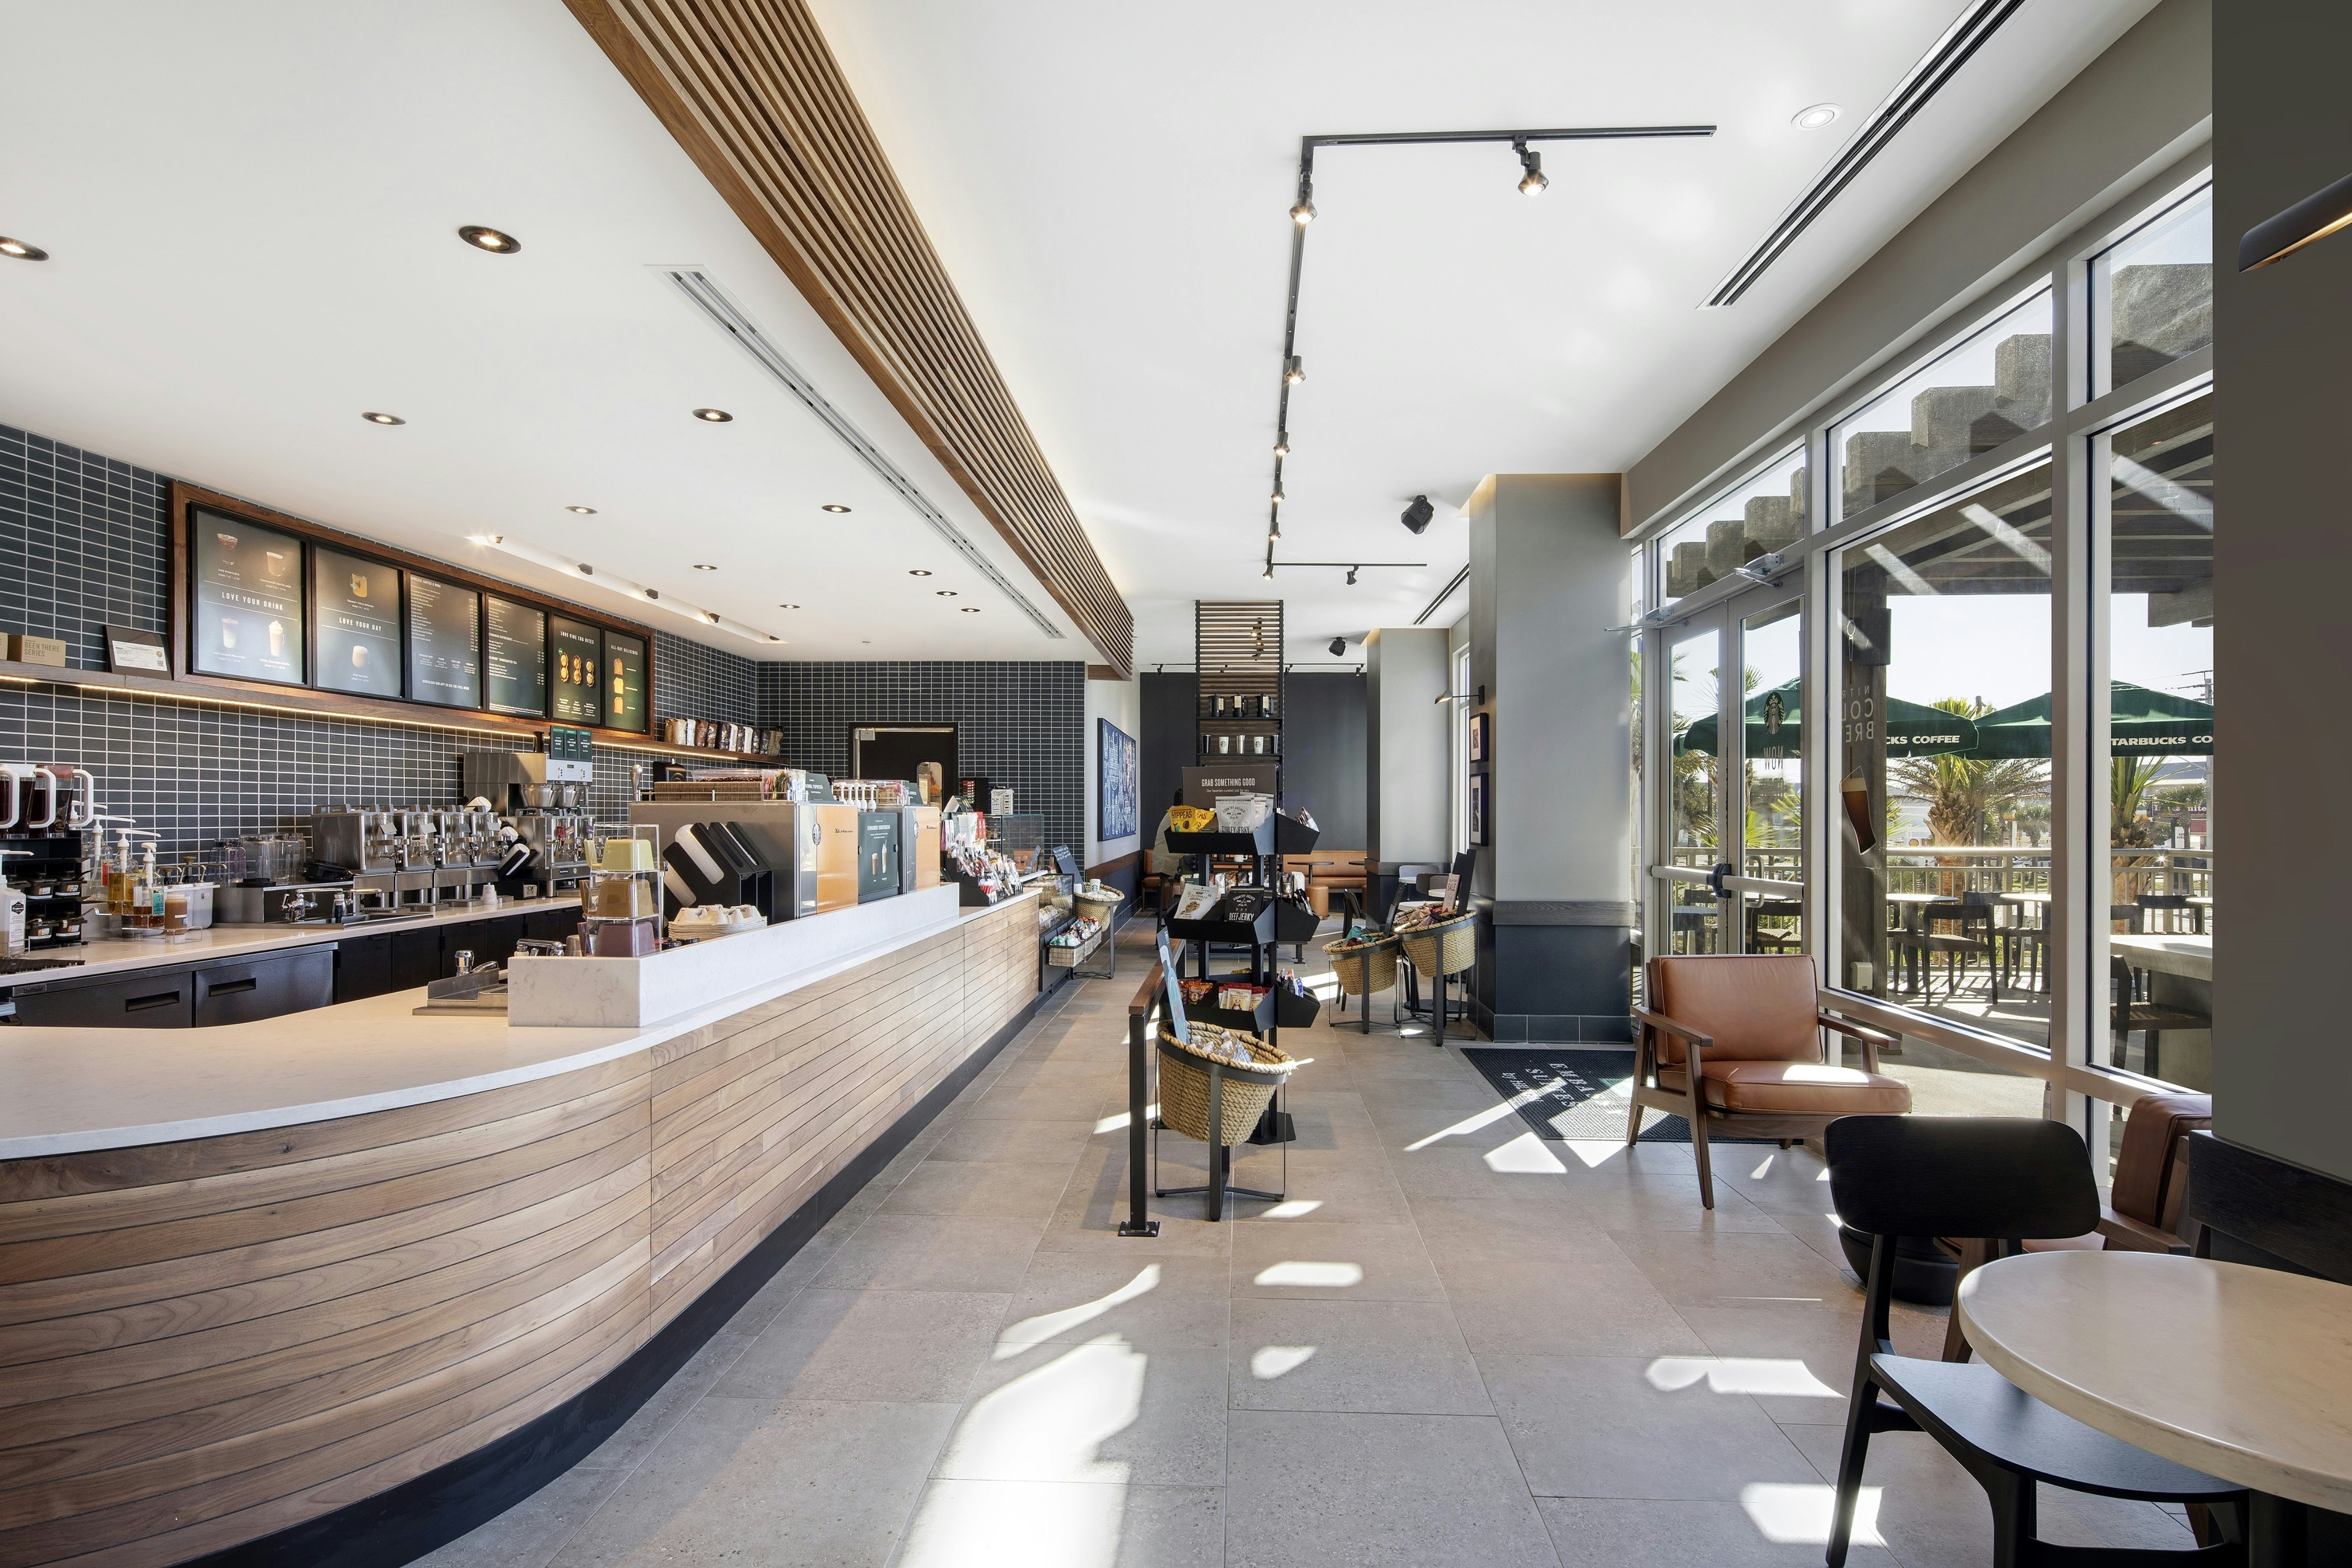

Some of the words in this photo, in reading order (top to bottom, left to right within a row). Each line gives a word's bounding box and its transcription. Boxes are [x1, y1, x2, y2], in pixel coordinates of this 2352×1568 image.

[222, 592, 239, 601] LOVE
[243, 596, 260, 606] YOUR
[263, 601, 283, 611] DRINK
[339, 617, 353, 626] LOVE
[356, 620, 370, 629] YOUR
[41, 644, 60, 652] THERE
[24, 649, 45, 657] SERIES
[1912, 735, 1959, 744] COFFEE
[1242, 778, 1255, 786] GOOD
[1238, 913, 1254, 921] JERKY
[1524, 1068, 1583, 1107] SUITES
